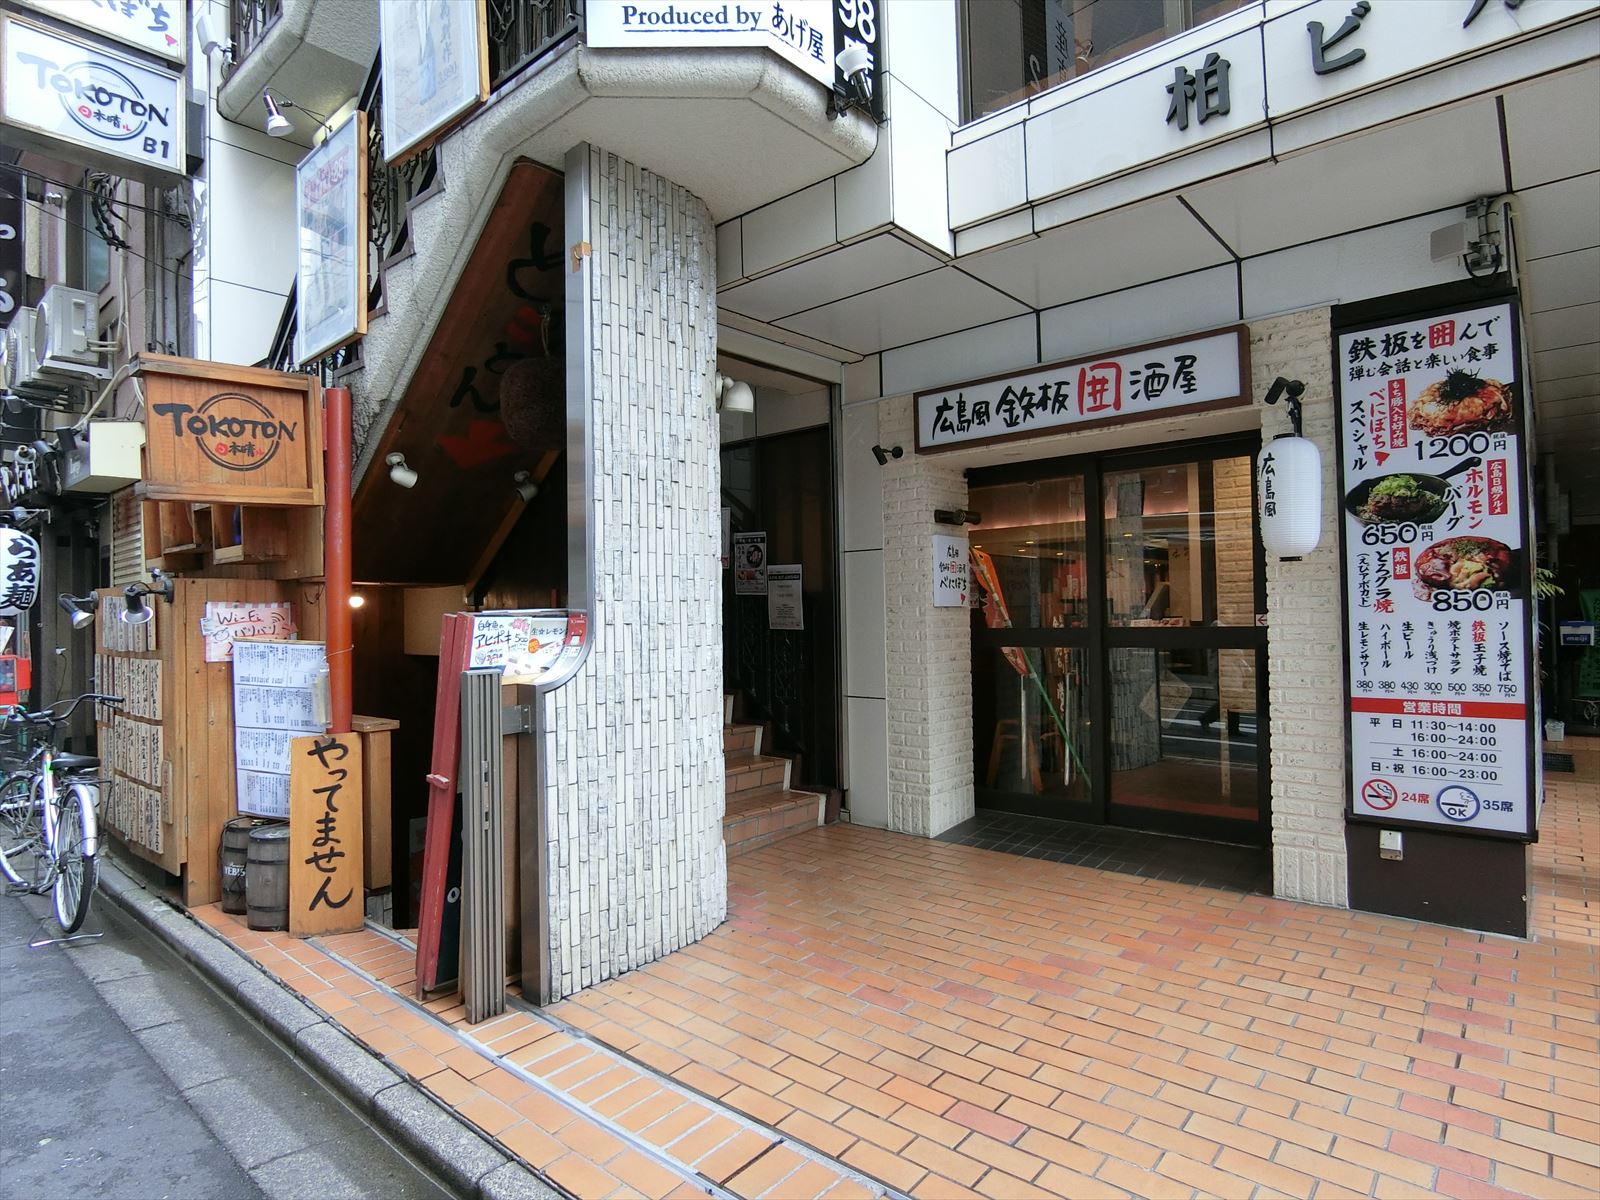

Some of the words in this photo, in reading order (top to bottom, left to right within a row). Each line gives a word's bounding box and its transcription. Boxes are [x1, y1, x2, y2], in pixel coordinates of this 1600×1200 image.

[622, 5, 728, 26] Produced
[736, 4, 762, 30] by
[771, 1, 826, 64] あげ屋
[16, 51, 169, 127] TOKOTON
[143, 136, 169, 159] B1
[1349, 315, 1500, 364] 鉄板を囲んで
[1349, 342, 1500, 383] 弾む会話と楽しい食事
[152, 403, 298, 443] TOKOTON
[1369, 387, 1386, 449] べにぼち
[1350, 400, 1369, 471] スペシャル
[1261, 452, 1277, 518] 広島風
[1444, 485, 1465, 532] バーグ
[1465, 468, 1484, 530] ホルモン
[1393, 550, 1409, 576] 鉄板
[939, 575, 967, 591] べにぼち
[1373, 550, 1394, 613] とろグラ焼
[217, 610, 262, 625] Wi-Fi
[474, 630, 512, 648] アヒポキ
[1358, 621, 1370, 677] 生レモンサワー
[1380, 623, 1392, 669] ハイボール
[1401, 621, 1415, 660] 生ビール
[1471, 620, 1488, 677] 鉄板玉子焼
[1498, 621, 1512, 682] ソース焼そば
[1356, 680, 1374, 689] 380
[1378, 681, 1396, 690] 380
[1400, 681, 1419, 690] 430
[1423, 682, 1443, 691] 300
[1447, 683, 1467, 692] 500
[1472, 683, 1492, 692] 350
[1497, 684, 1517, 694] 750
[1402, 701, 1462, 715] 営業時間
[1392, 747, 1404, 757] 土
[1401, 791, 1431, 805] 24席
[1482, 799, 1514, 813] 35席
[304, 737, 354, 912] やってません
[1447, 807, 1468, 818] OK
